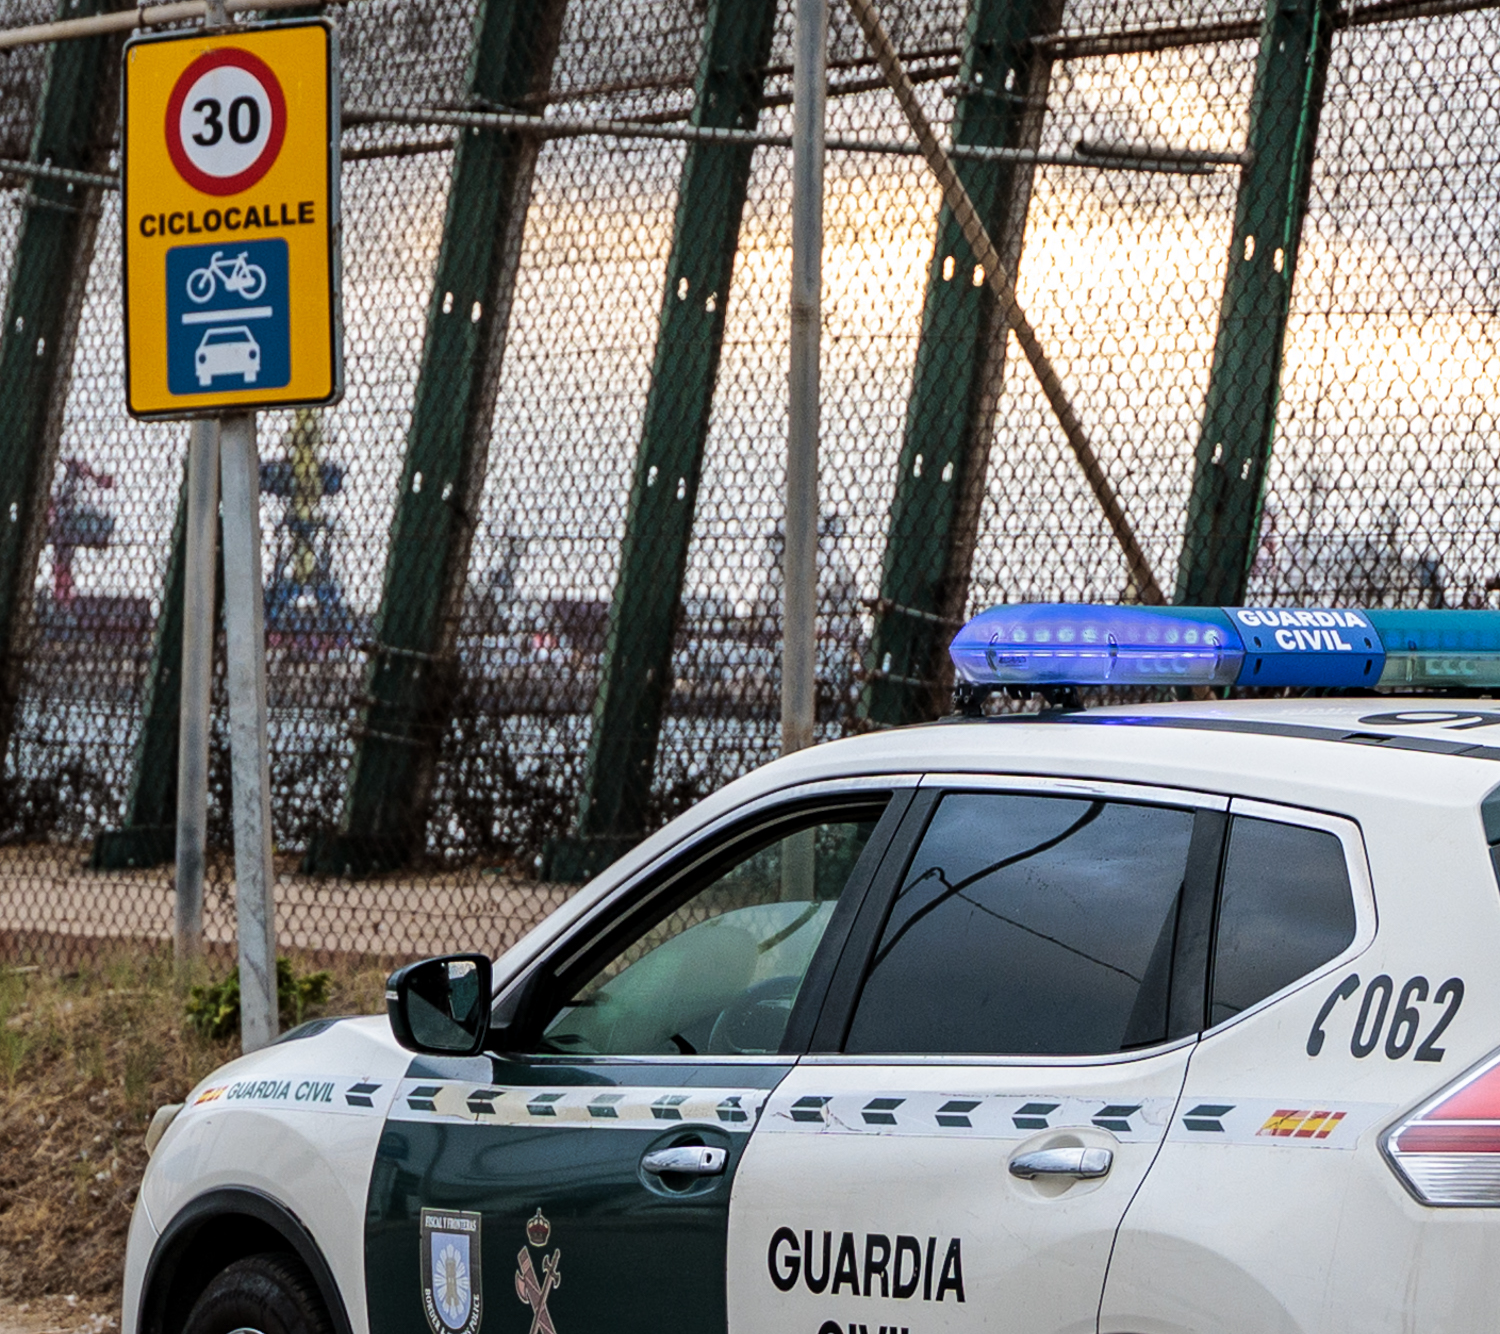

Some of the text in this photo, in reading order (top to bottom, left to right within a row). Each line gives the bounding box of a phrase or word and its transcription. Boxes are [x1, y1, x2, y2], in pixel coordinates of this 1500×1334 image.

[192, 95, 260, 146] 30
[139, 201, 315, 237] CICLOCALLE
[1236, 610, 1367, 628] GUARDIA
[1274, 629, 1352, 651] CIVIL
[1350, 974, 1465, 1062] 062
[226, 1080, 335, 1103] GUARDIA CIVIL
[425, 1215, 442, 1229] FISCAL
[447, 1217, 477, 1231] FRONTERAS
[768, 1226, 965, 1302] GUARDIA
[424, 1288, 440, 1332] BORDER
[469, 1293, 480, 1332] POLICE
